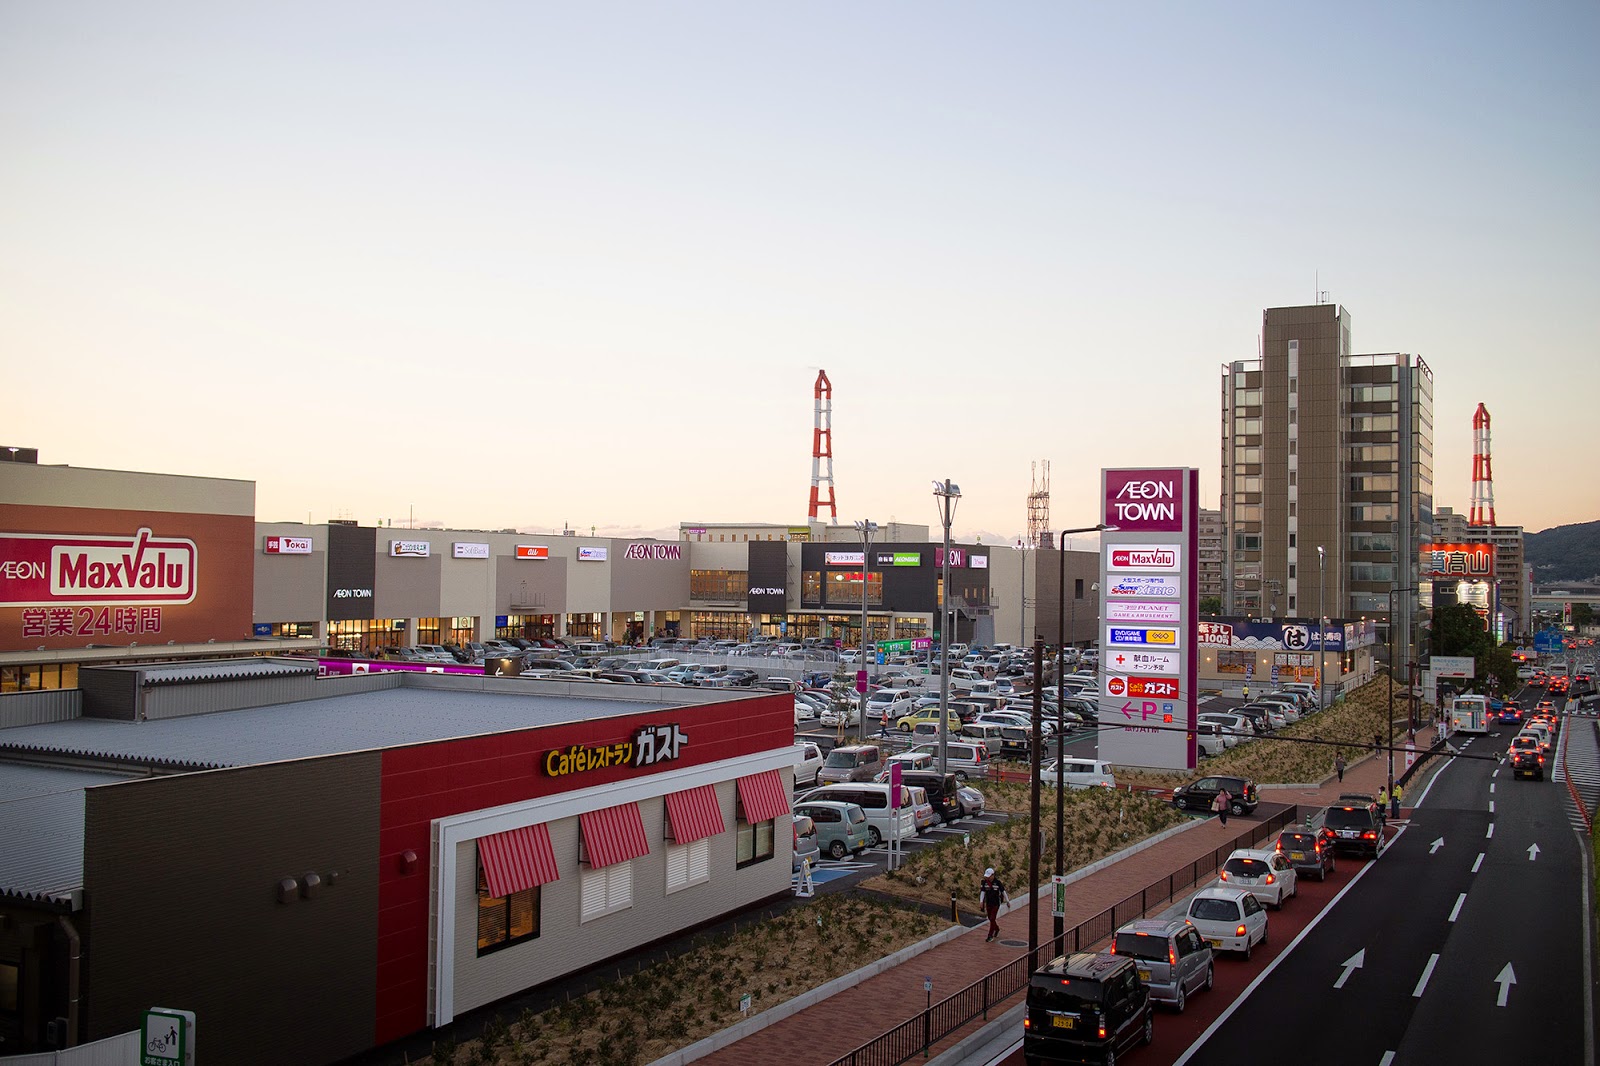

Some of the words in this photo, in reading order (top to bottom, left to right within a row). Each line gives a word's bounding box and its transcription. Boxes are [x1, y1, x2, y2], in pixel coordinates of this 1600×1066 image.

[1114, 503, 1174, 521] TOWN
[464, 546, 487, 555] SoftBank
[653, 544, 681, 560] TOWN
[1132, 548, 1171, 564] MaxValu
[59, 532, 183, 589] MaxValu
[353, 589, 372, 598] TOWN
[766, 587, 785, 595] TOWN
[1136, 584, 1177, 596] XEBIO
[22, 606, 161, 638] 営業24時間
[1287, 629, 1306, 647] は
[1133, 654, 1170, 663] 献血ルーム
[1144, 682, 1177, 695] ガスト
[1142, 701, 1158, 721] P
[636, 724, 689, 767] ガスト
